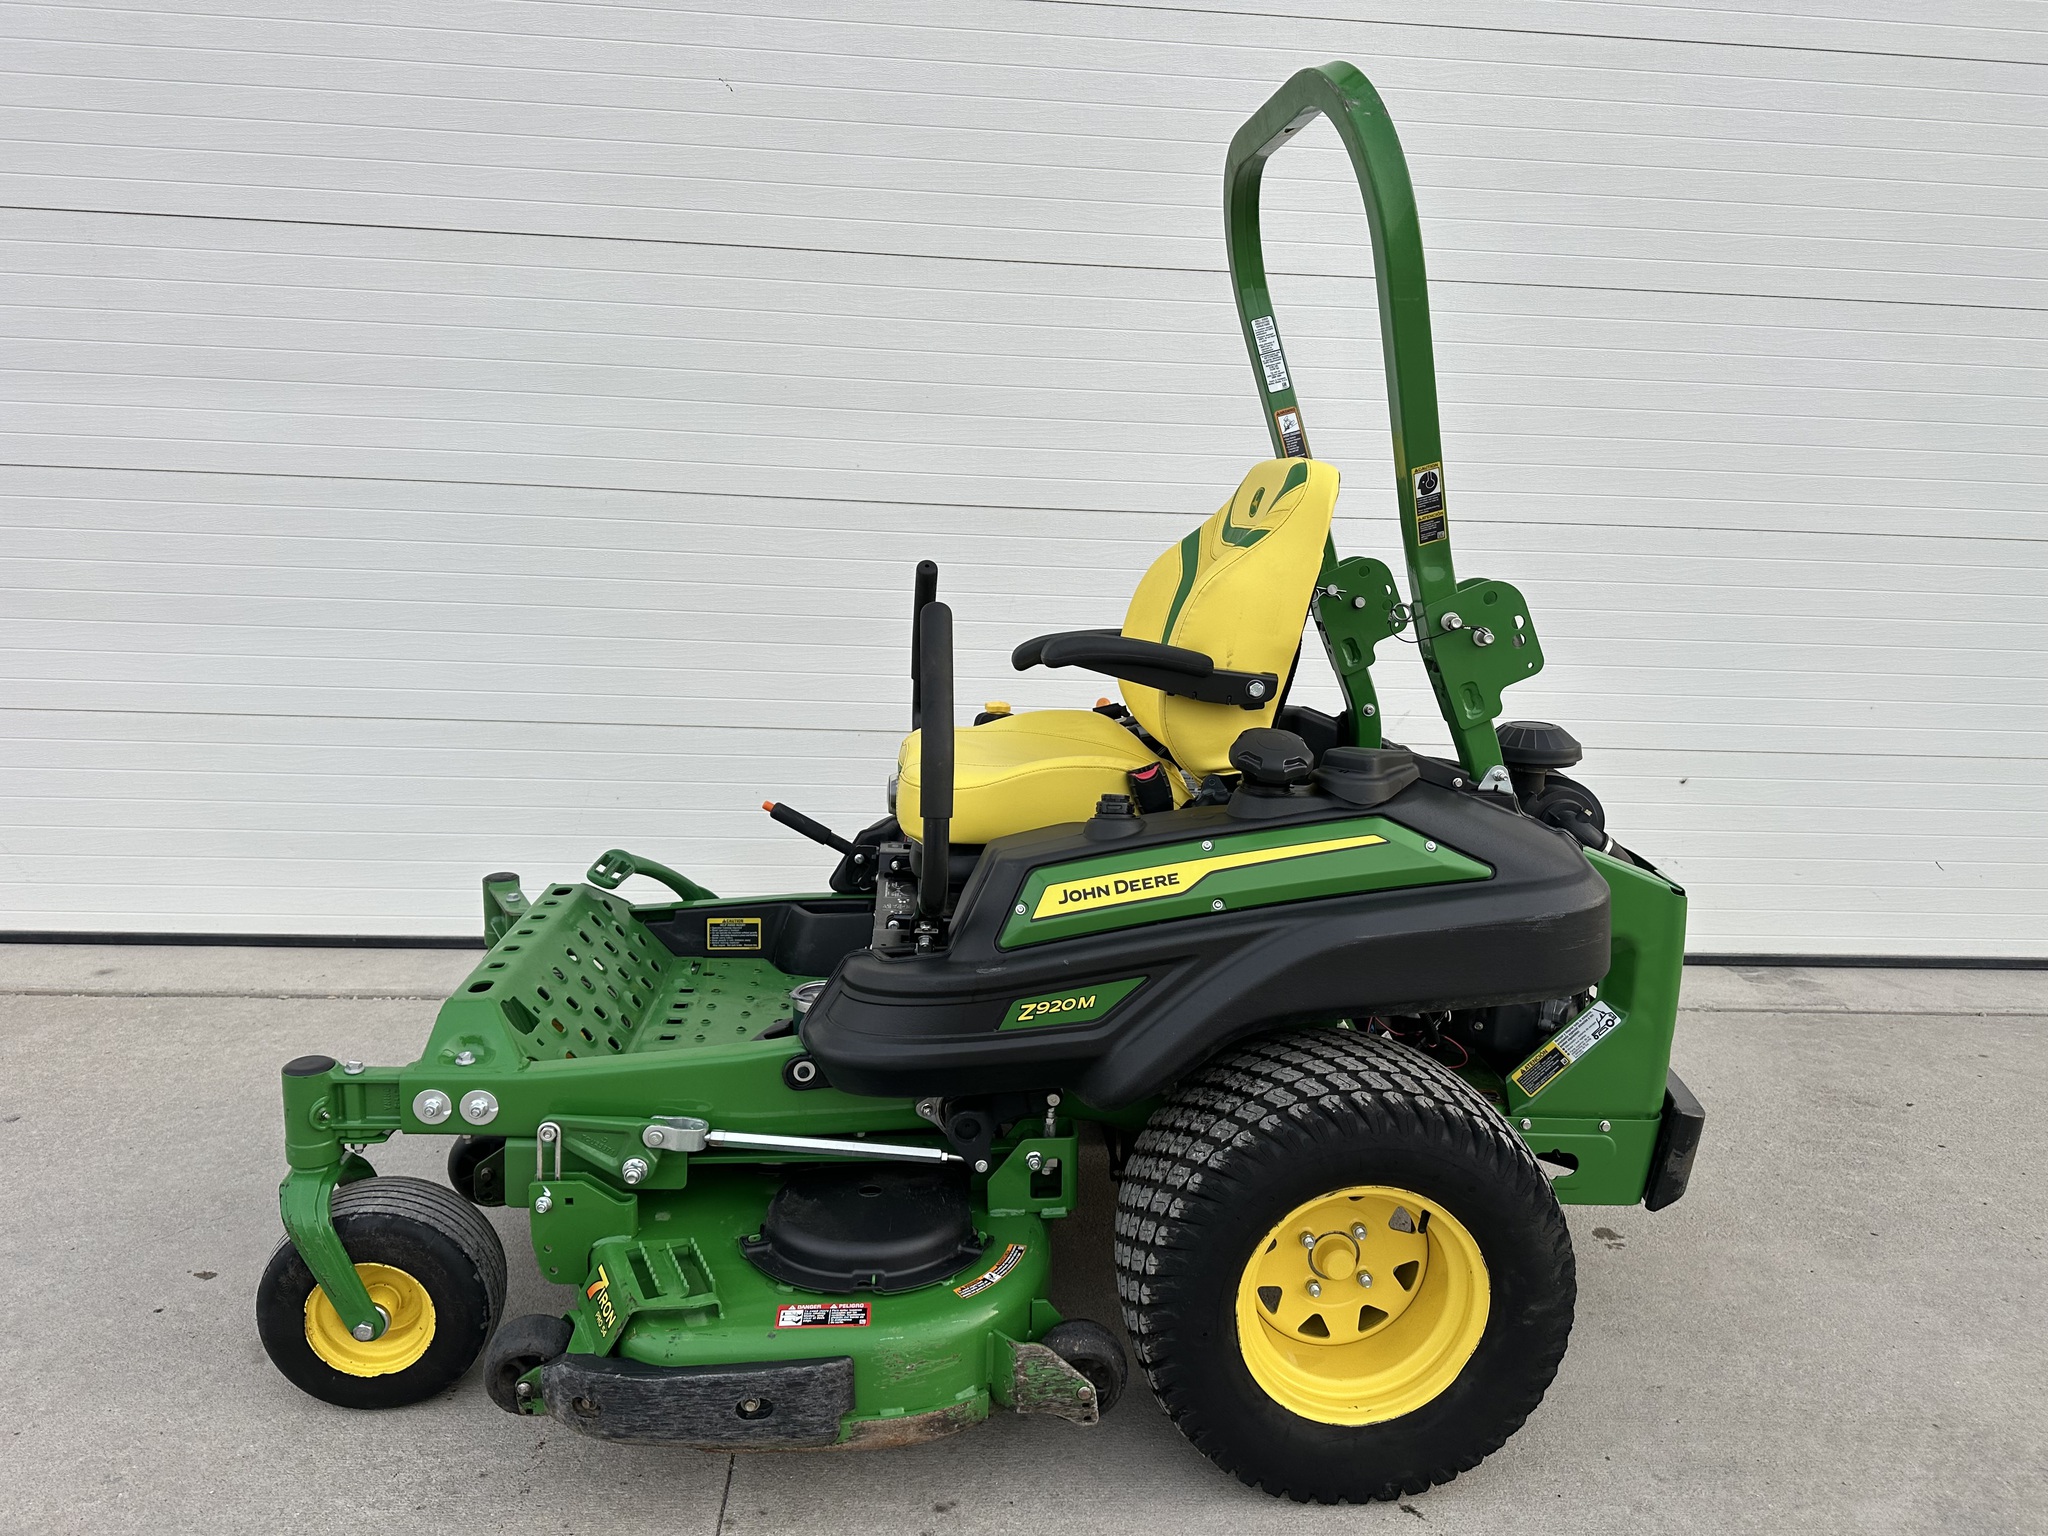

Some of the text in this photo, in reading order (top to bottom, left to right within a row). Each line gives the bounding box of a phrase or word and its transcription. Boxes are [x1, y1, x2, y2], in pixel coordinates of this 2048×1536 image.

[1058, 872, 1180, 905] JOHN DEERE
[1016, 995, 1096, 1022] Z920M
